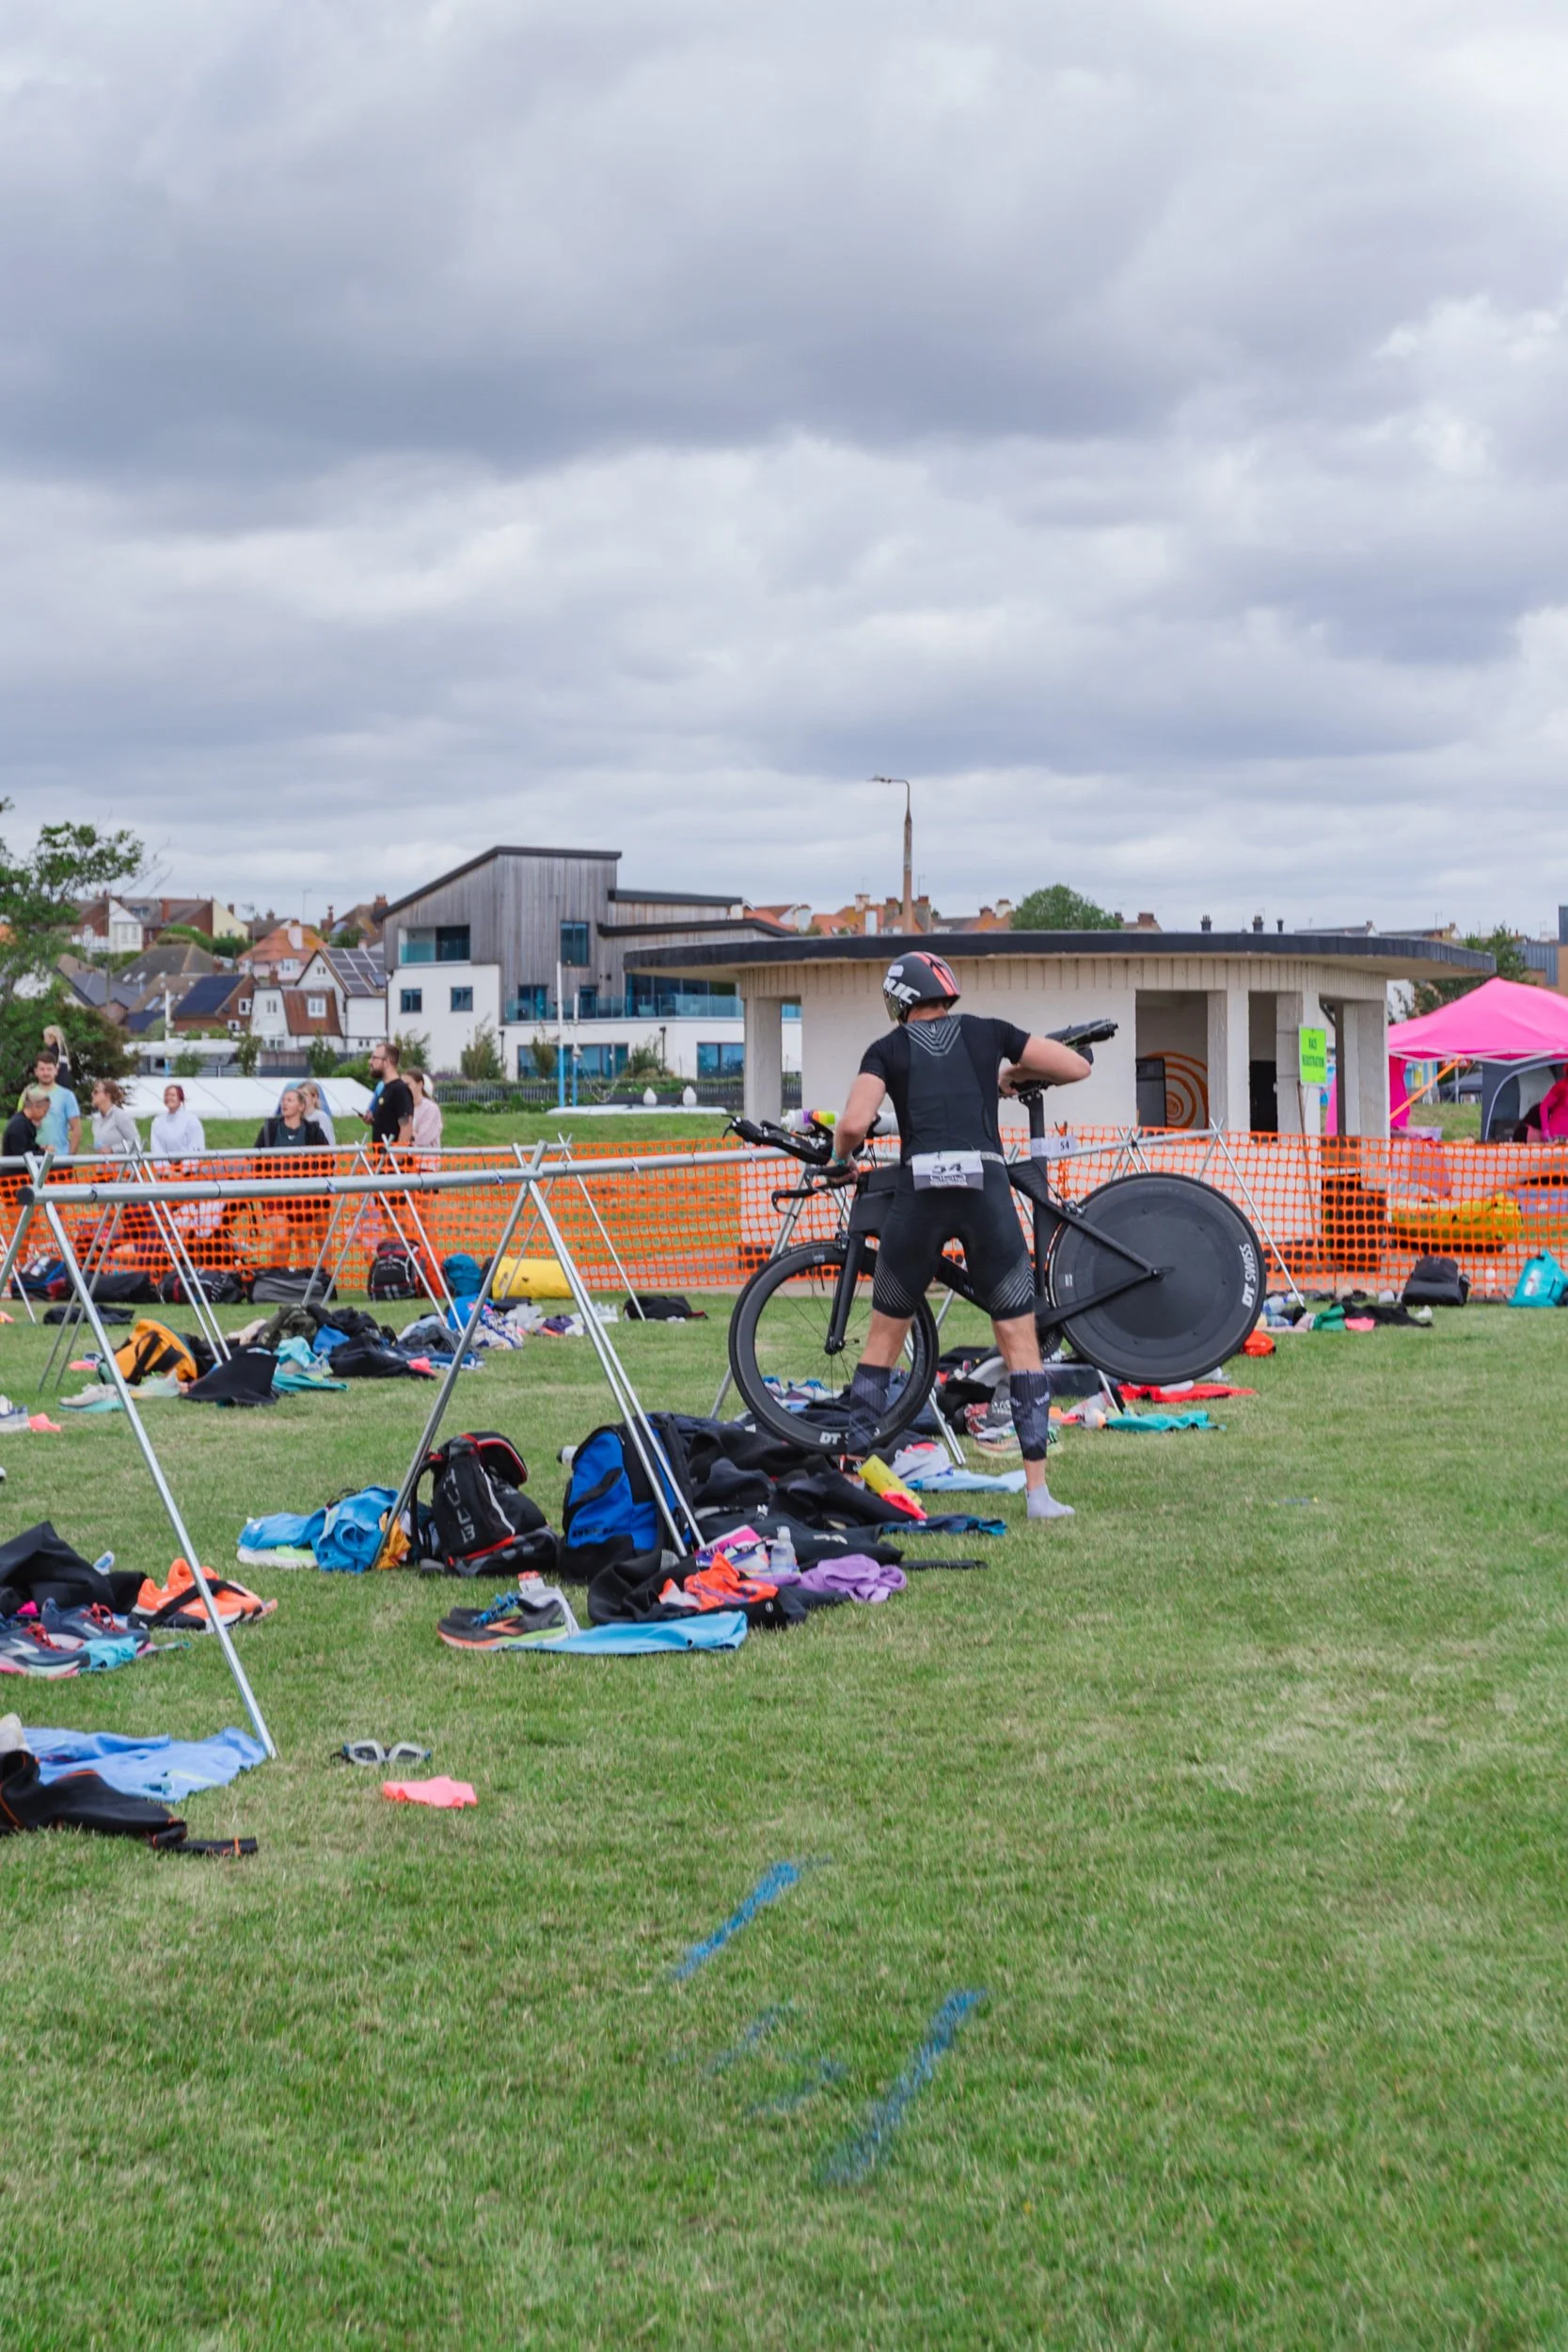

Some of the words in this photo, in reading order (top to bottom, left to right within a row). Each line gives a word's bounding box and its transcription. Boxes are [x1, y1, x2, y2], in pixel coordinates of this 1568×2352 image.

[1308, 1038, 1318, 1050] RACE
[1302, 1054, 1325, 1069] REGISTRATION
[1238, 1243, 1257, 1283] SWISS
[1241, 1282, 1256, 1309] DT
[819, 1431, 842, 1445] DT
